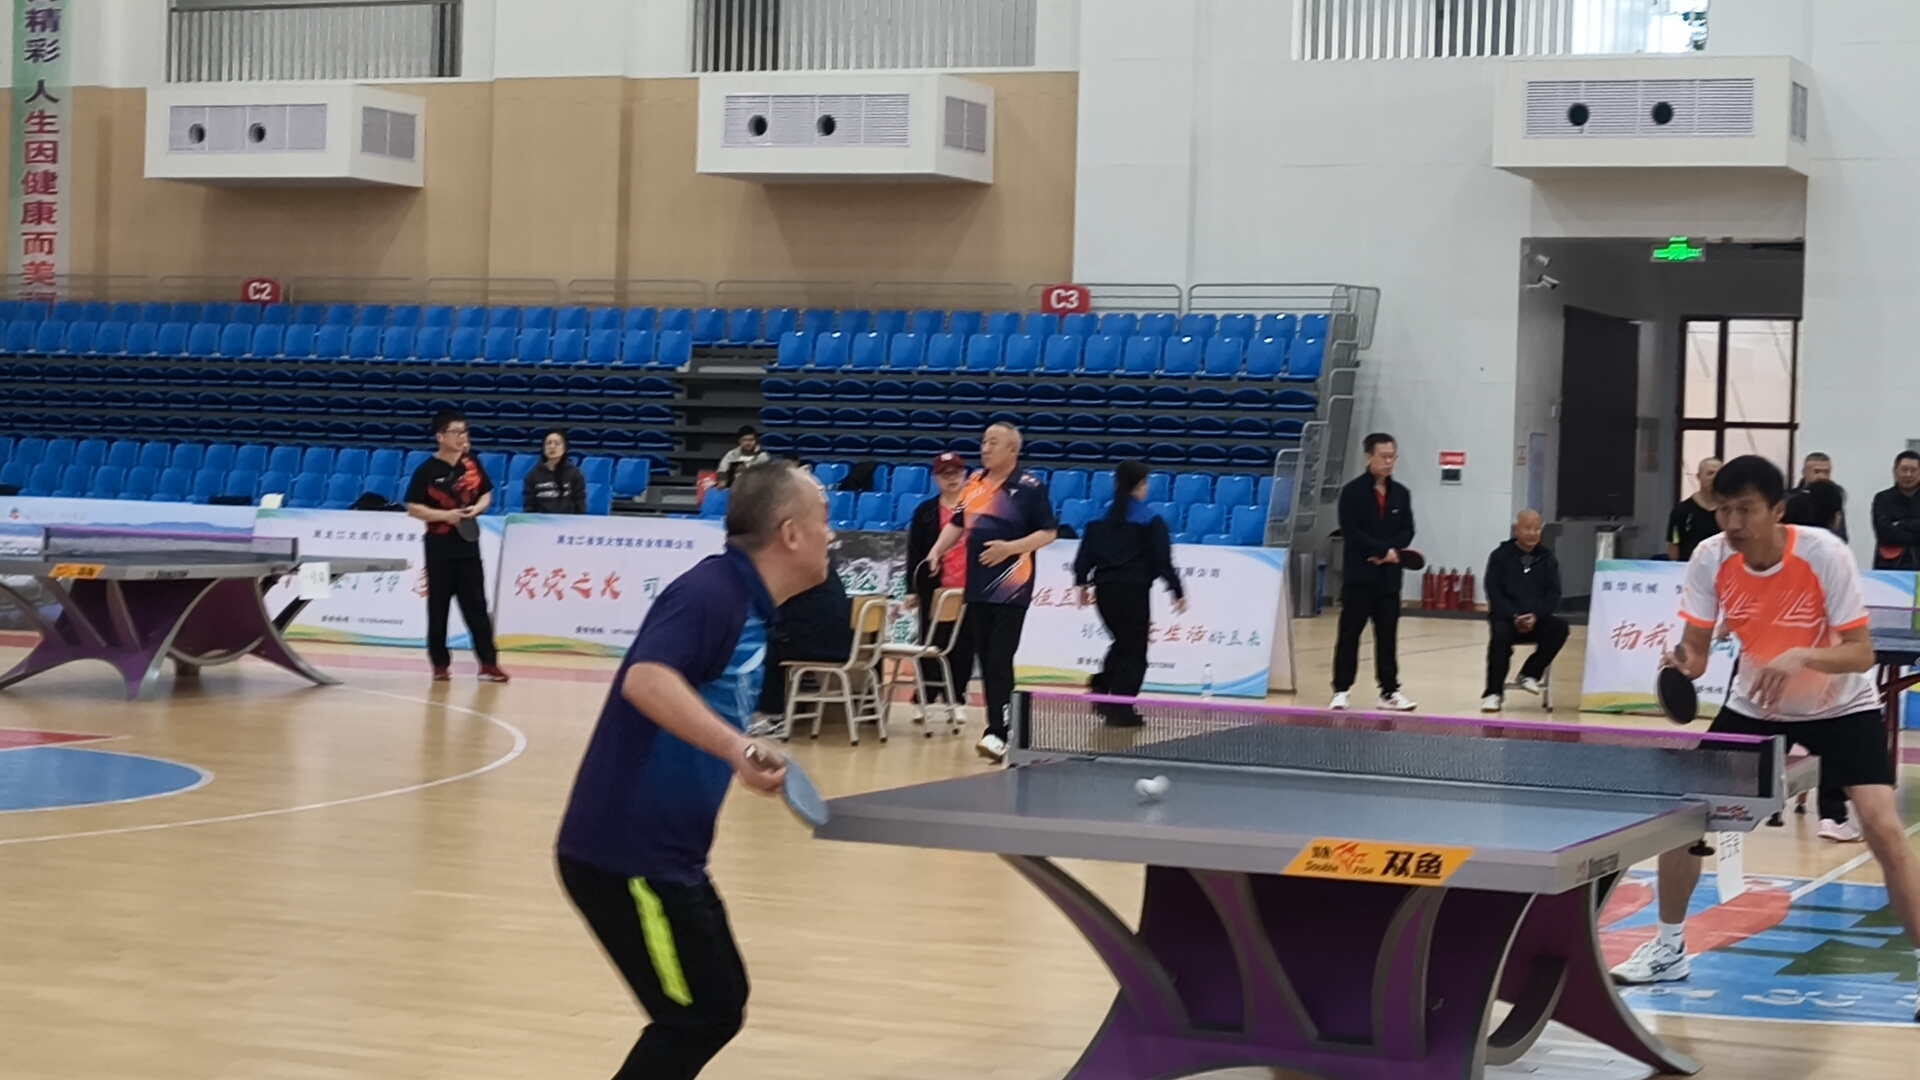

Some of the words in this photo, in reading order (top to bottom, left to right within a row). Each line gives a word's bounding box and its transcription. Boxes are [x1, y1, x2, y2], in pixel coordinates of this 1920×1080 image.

[24, 0, 62, 63] 精彩
[248, 282, 272, 300] C2
[1050, 288, 1079, 309] C3
[1380, 849, 1444, 879] 双鱼
